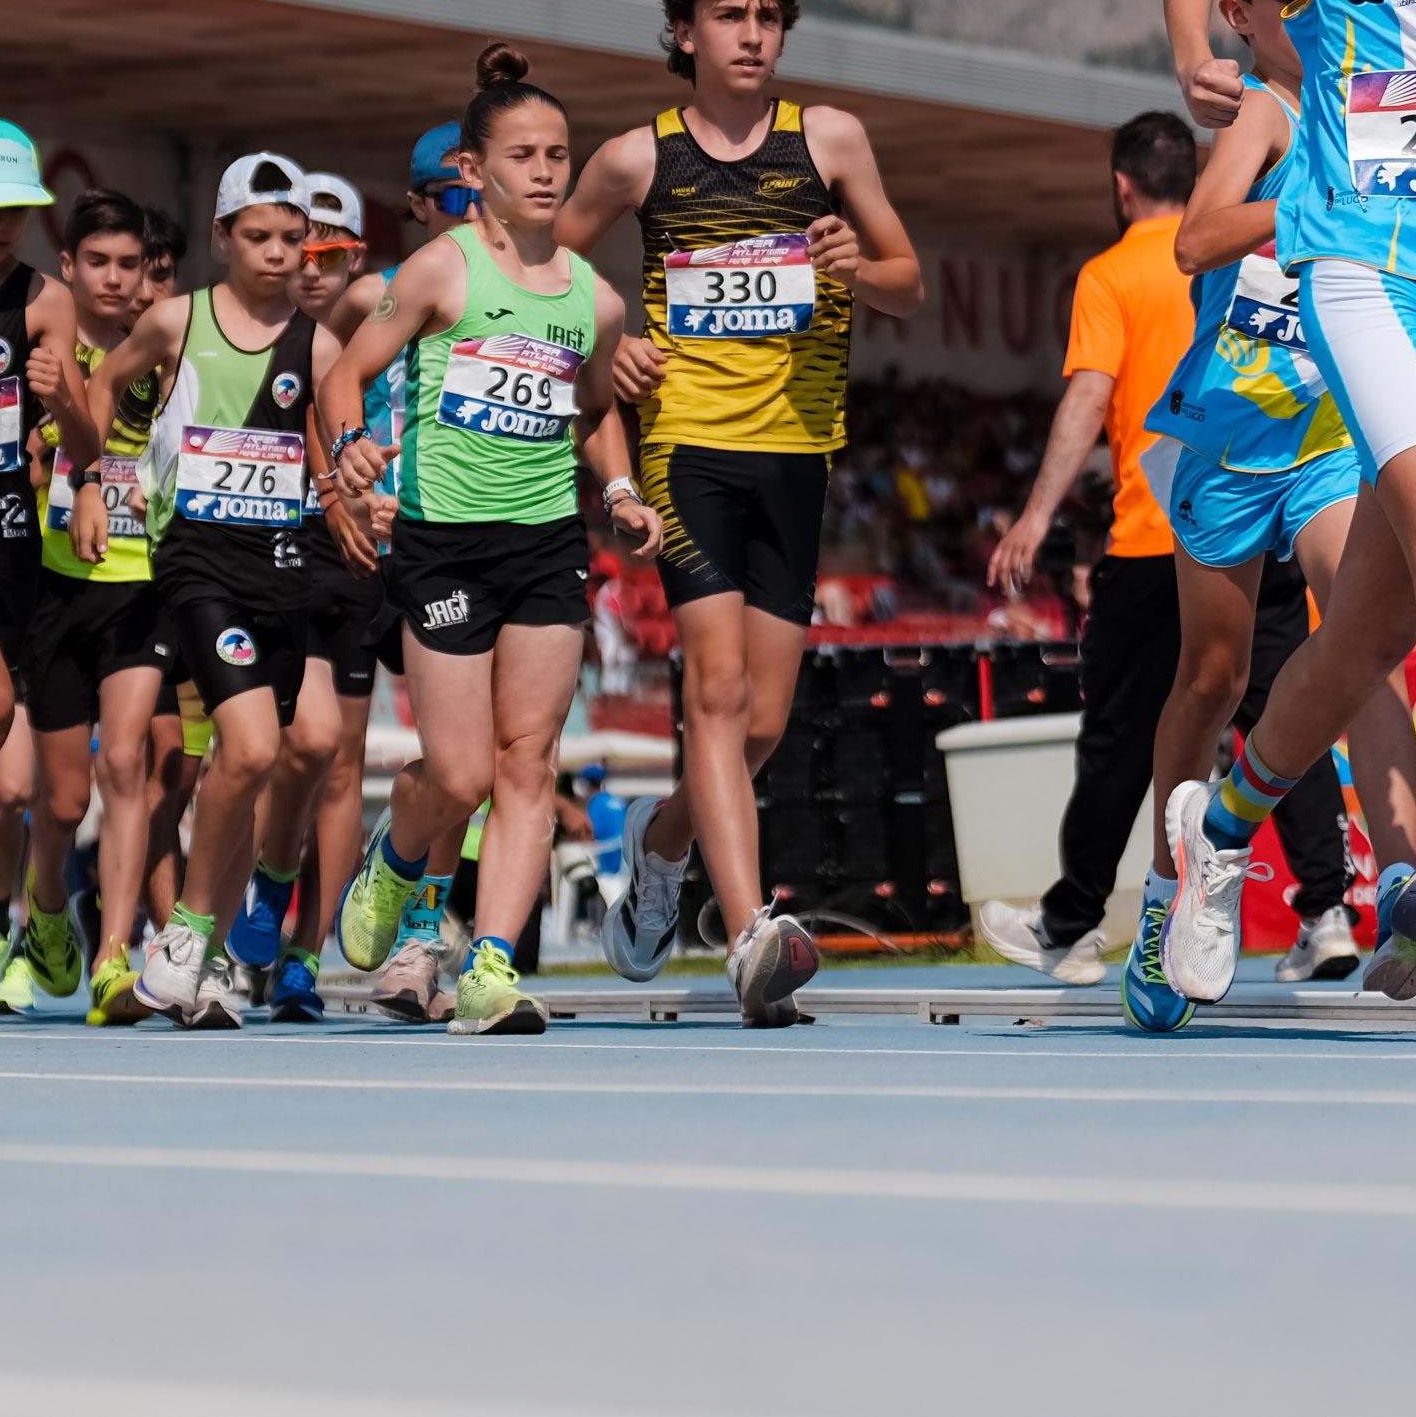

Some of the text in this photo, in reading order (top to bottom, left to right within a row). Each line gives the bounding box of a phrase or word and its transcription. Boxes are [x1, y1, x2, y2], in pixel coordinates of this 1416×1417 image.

[762, 179, 800, 190] SPRINT
[703, 270, 777, 304] 330
[708, 308, 795, 334] Joma
[483, 366, 553, 411] 269
[480, 406, 561, 438] Joma
[211, 460, 277, 495] 276
[212, 496, 289, 521] Joma
